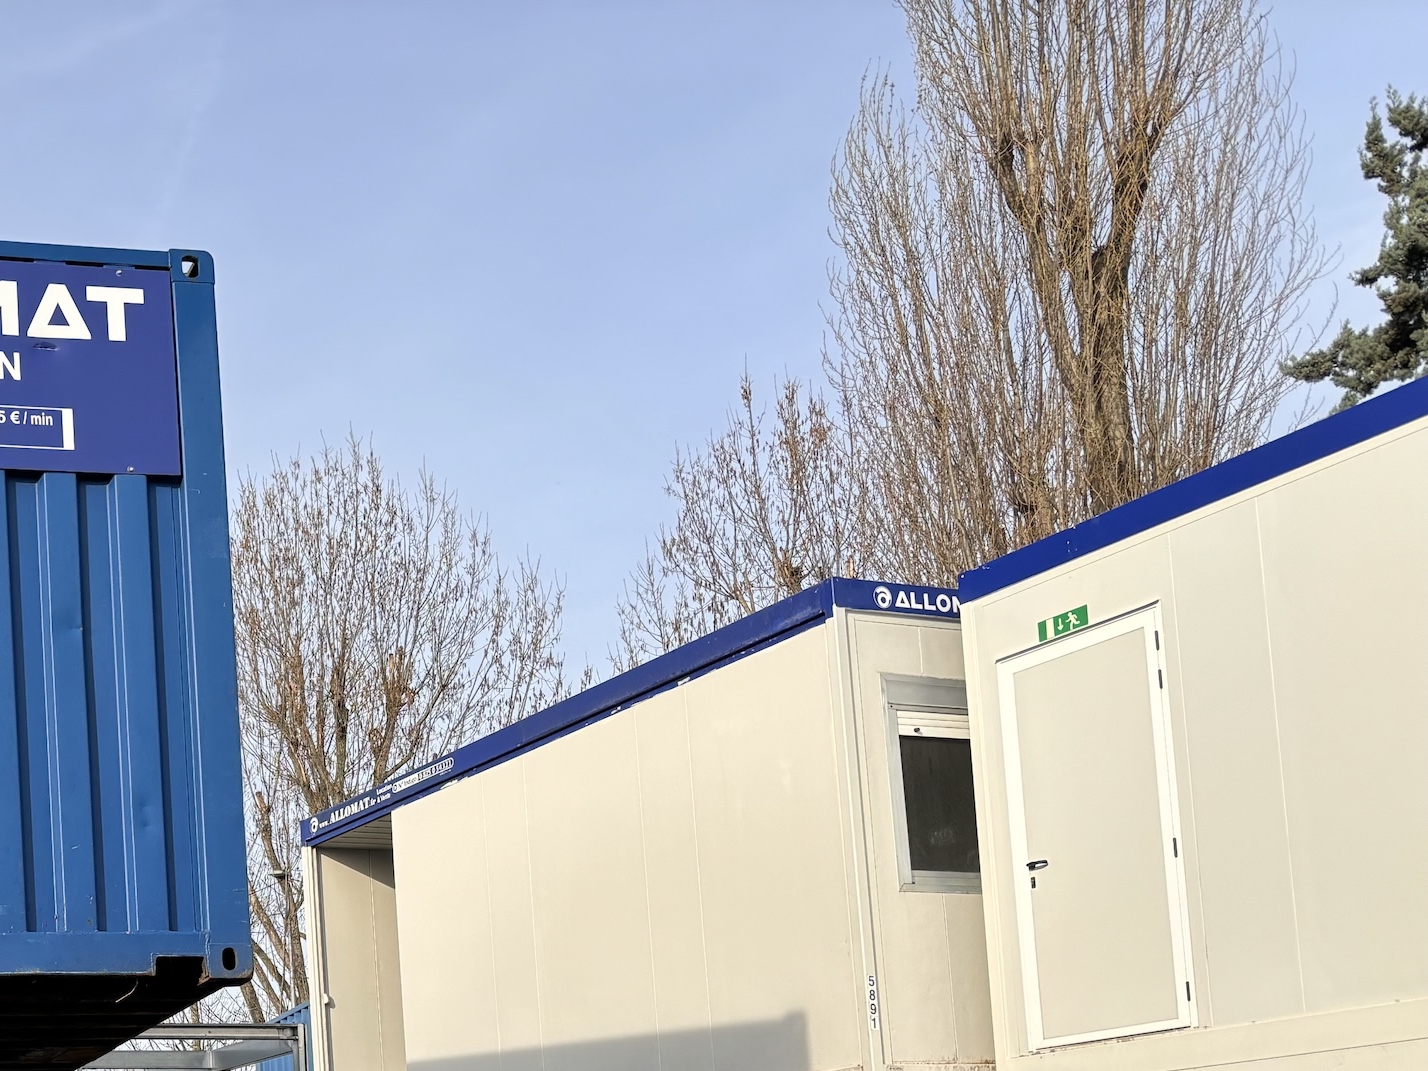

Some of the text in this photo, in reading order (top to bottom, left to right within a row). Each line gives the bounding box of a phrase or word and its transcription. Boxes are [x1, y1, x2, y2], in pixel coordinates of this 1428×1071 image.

[10, 410, 20, 425] €
[23, 411, 28, 425] /
[30, 412, 54, 426] min
[868, 975, 877, 1029] 5891
